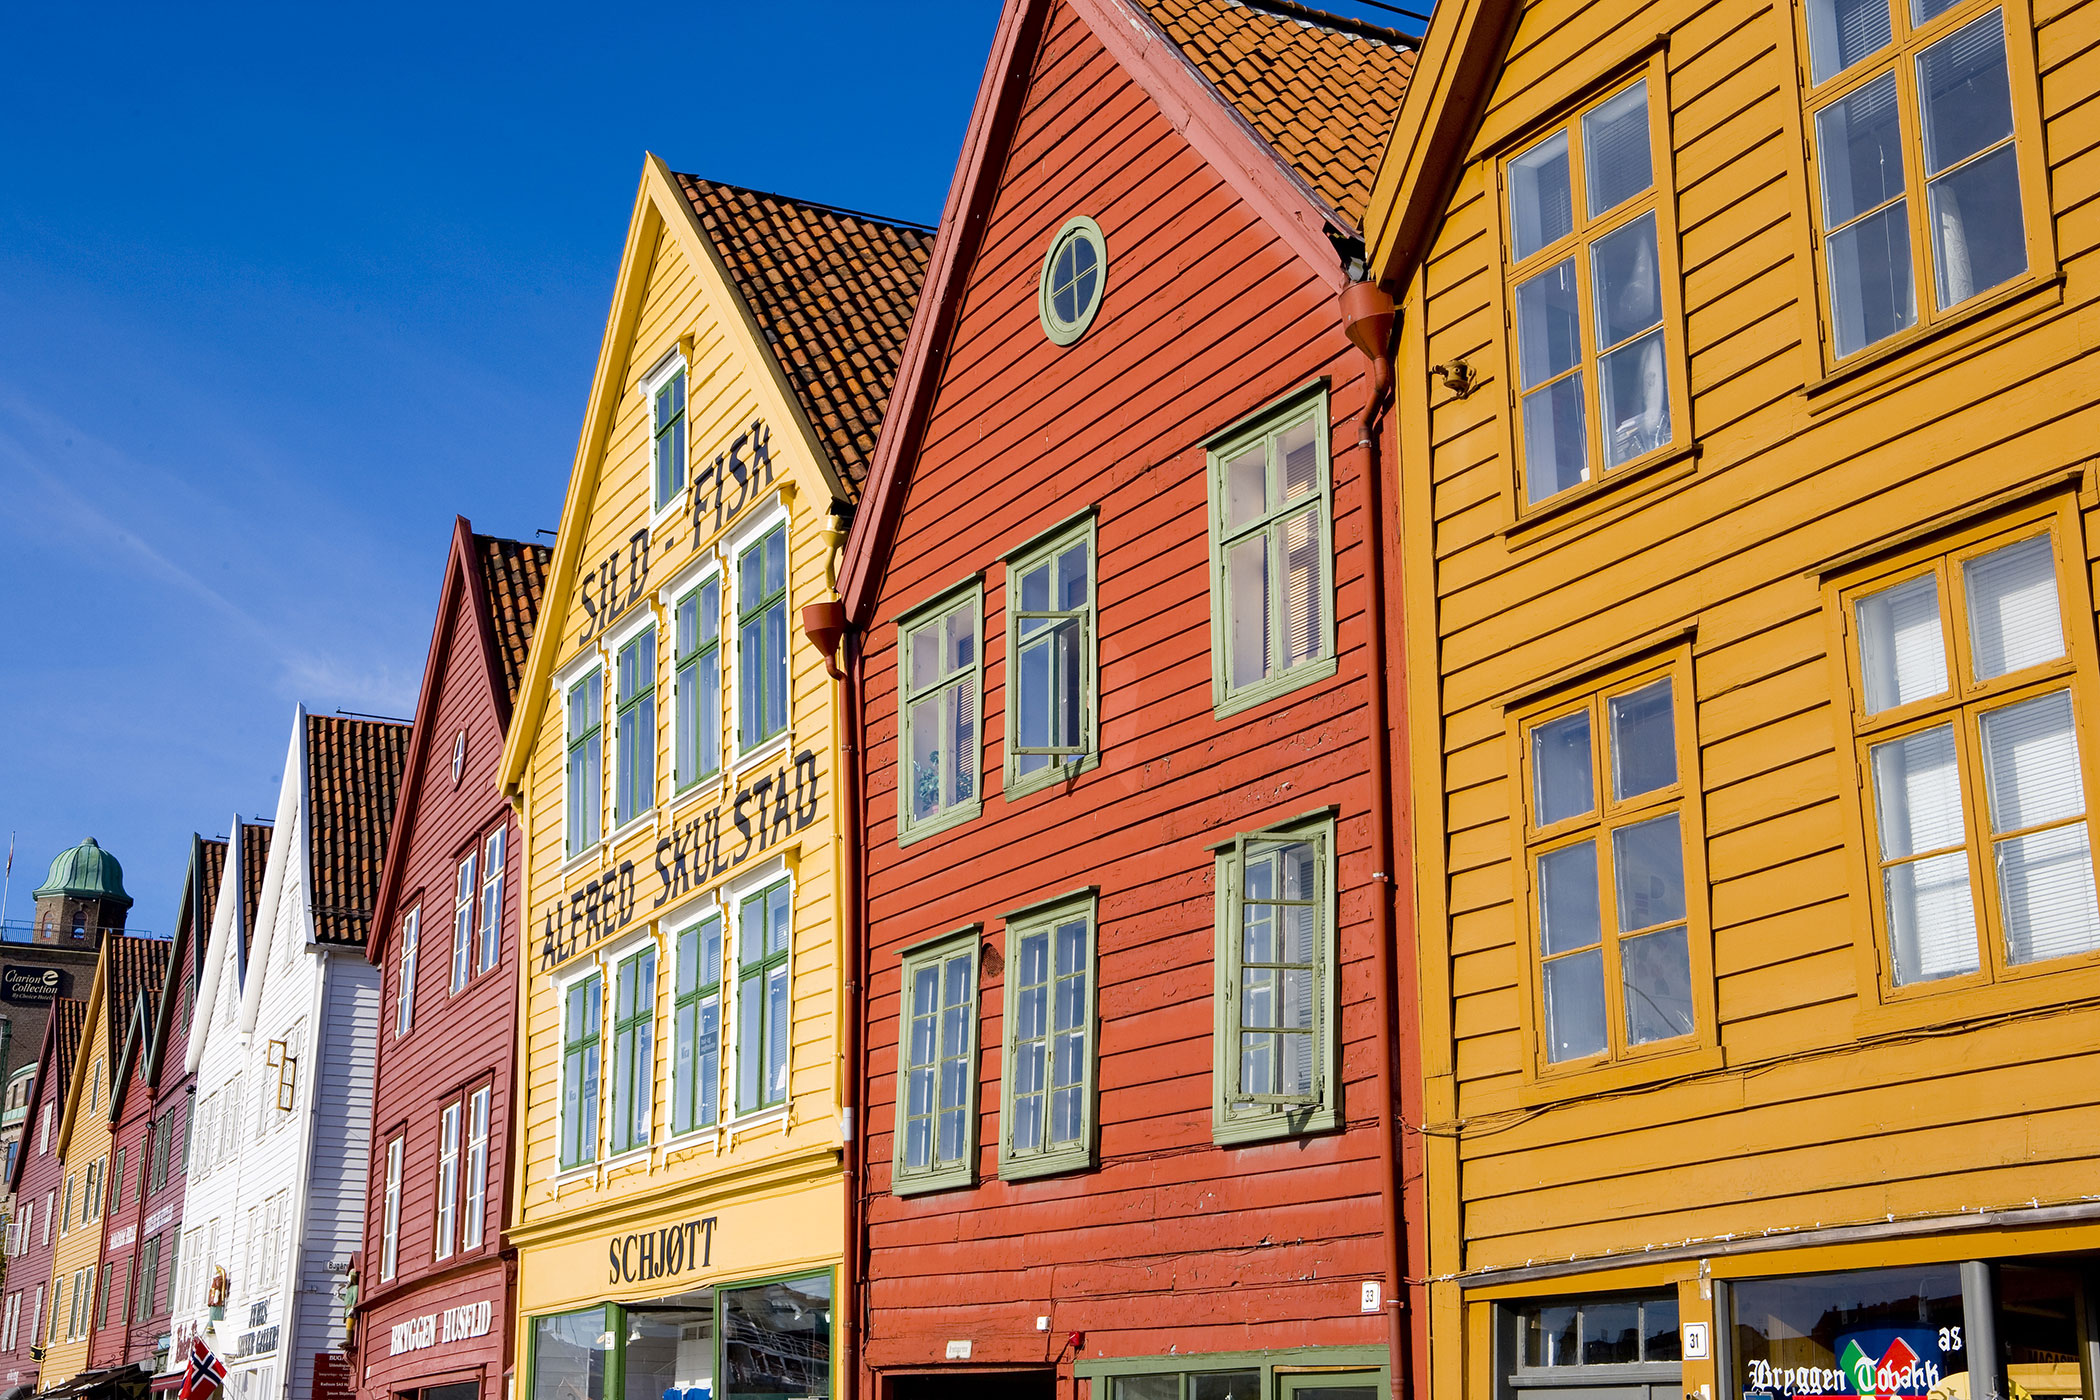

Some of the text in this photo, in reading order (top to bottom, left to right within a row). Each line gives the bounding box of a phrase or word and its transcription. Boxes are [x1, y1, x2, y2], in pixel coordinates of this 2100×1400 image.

[579, 528, 650, 647] SILD
[692, 417, 775, 553] FISK
[541, 859, 636, 972] ALFRED
[5, 969, 41, 984] Clarion
[12, 983, 58, 994] Collection
[609, 1216, 718, 1285] SCHJØTT
[1365, 1289, 1374, 1303] 33
[389, 1300, 493, 1357] BRYGGEN HUSFLID
[1689, 1332, 1699, 1349] 31
[1937, 1326, 1963, 1352] as
[1748, 1356, 1943, 1397] Bryggen Tobakk
